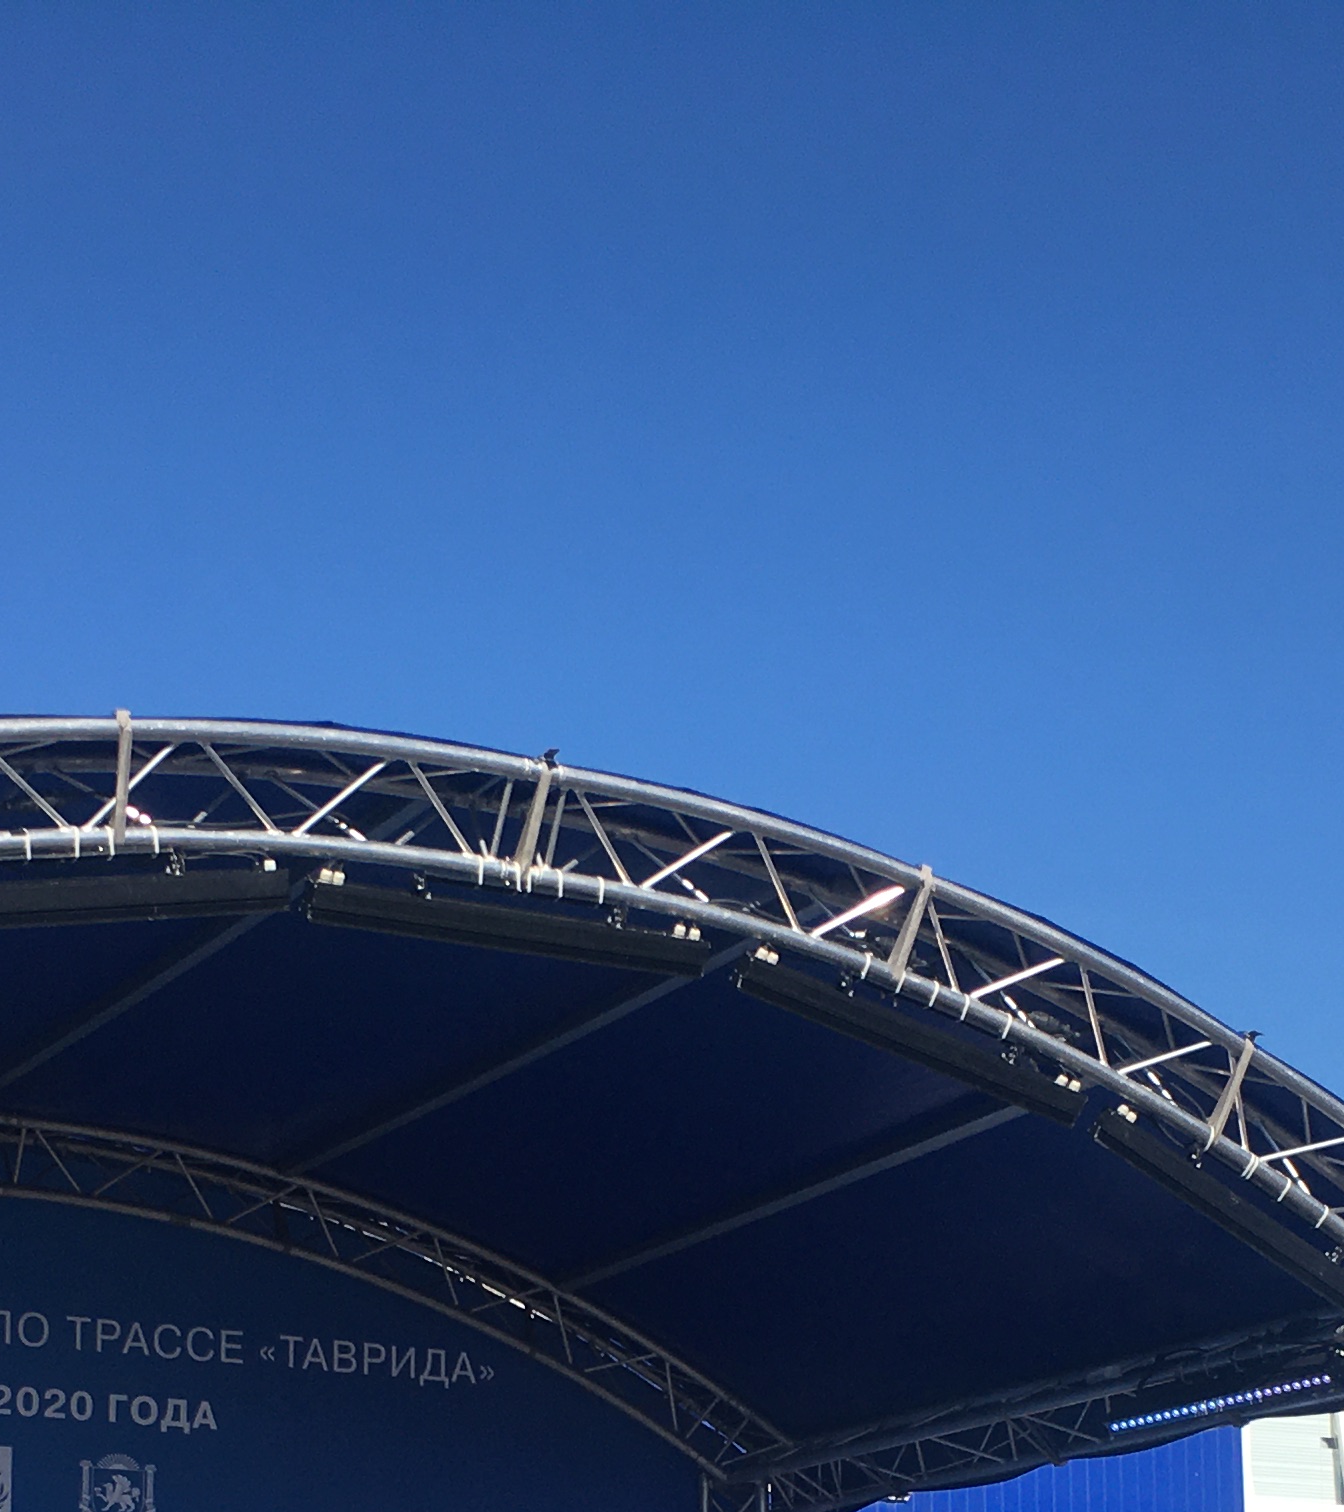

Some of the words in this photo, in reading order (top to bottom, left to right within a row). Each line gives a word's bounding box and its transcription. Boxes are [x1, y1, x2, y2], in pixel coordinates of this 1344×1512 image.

[66, 1315, 244, 1365] ТРАССЕ
[259, 1334, 495, 1389] «ТАВРИДА»
[108, 1393, 218, 1434] ГОДА
